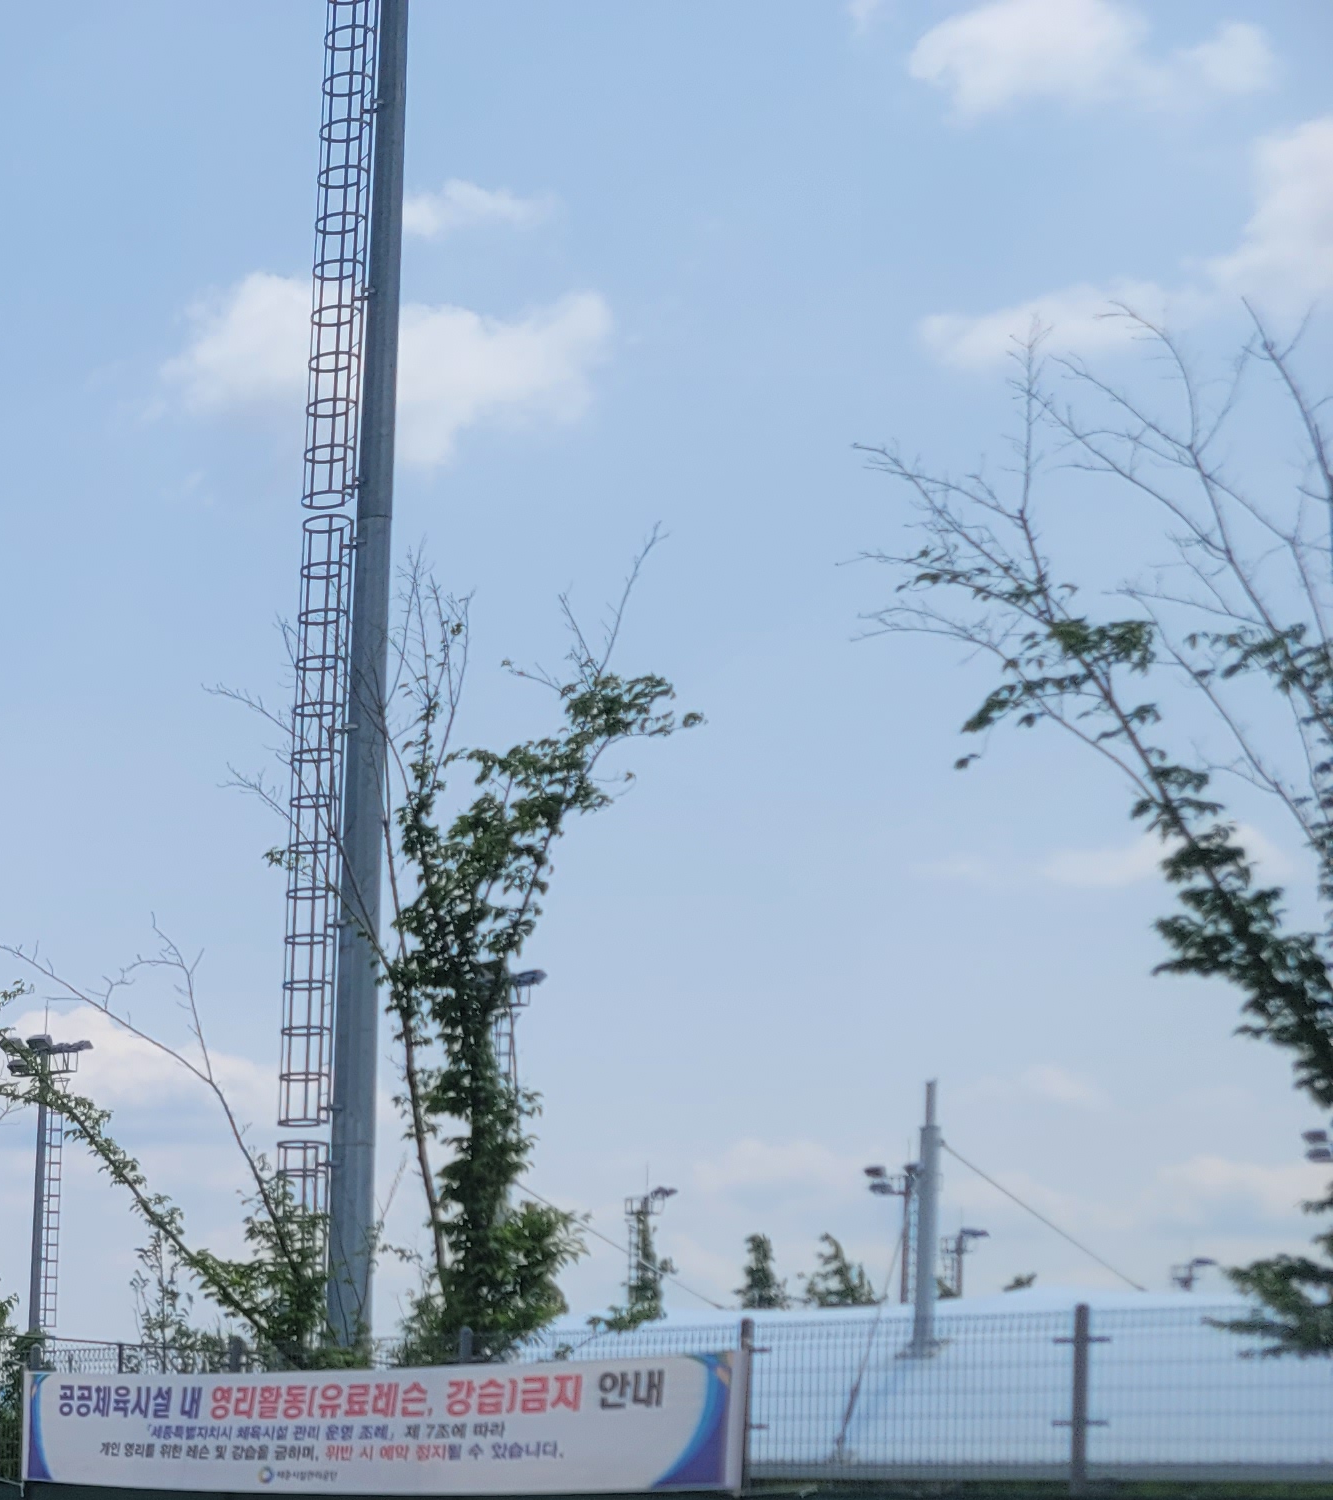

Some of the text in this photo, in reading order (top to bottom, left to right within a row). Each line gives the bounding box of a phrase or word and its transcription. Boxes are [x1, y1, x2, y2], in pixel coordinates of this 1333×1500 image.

[58, 1384, 172, 1419] 공공체육시설
[180, 1386, 203, 1419] 내
[598, 1369, 665, 1410] 안내
[236, 1425, 288, 1440] 체육시설
[293, 1425, 320, 1440] 관리
[404, 1423, 420, 1439] 제
[426, 1422, 466, 1439] 7조에
[473, 1421, 505, 1438] 따라
[100, 1442, 120, 1457] 개인
[124, 1443, 155, 1459] 영리를
[160, 1444, 181, 1459] 위한
[186, 1444, 210, 1460] 레슨
[215, 1445, 226, 1460] 및
[232, 1445, 269, 1461] 강습을
[325, 1444, 353, 1461] 위반
[360, 1444, 374, 1461] 시
[379, 1443, 411, 1461] 예약
[468, 1443, 484, 1460] 수
[491, 1440, 564, 1460] 있습니다.
